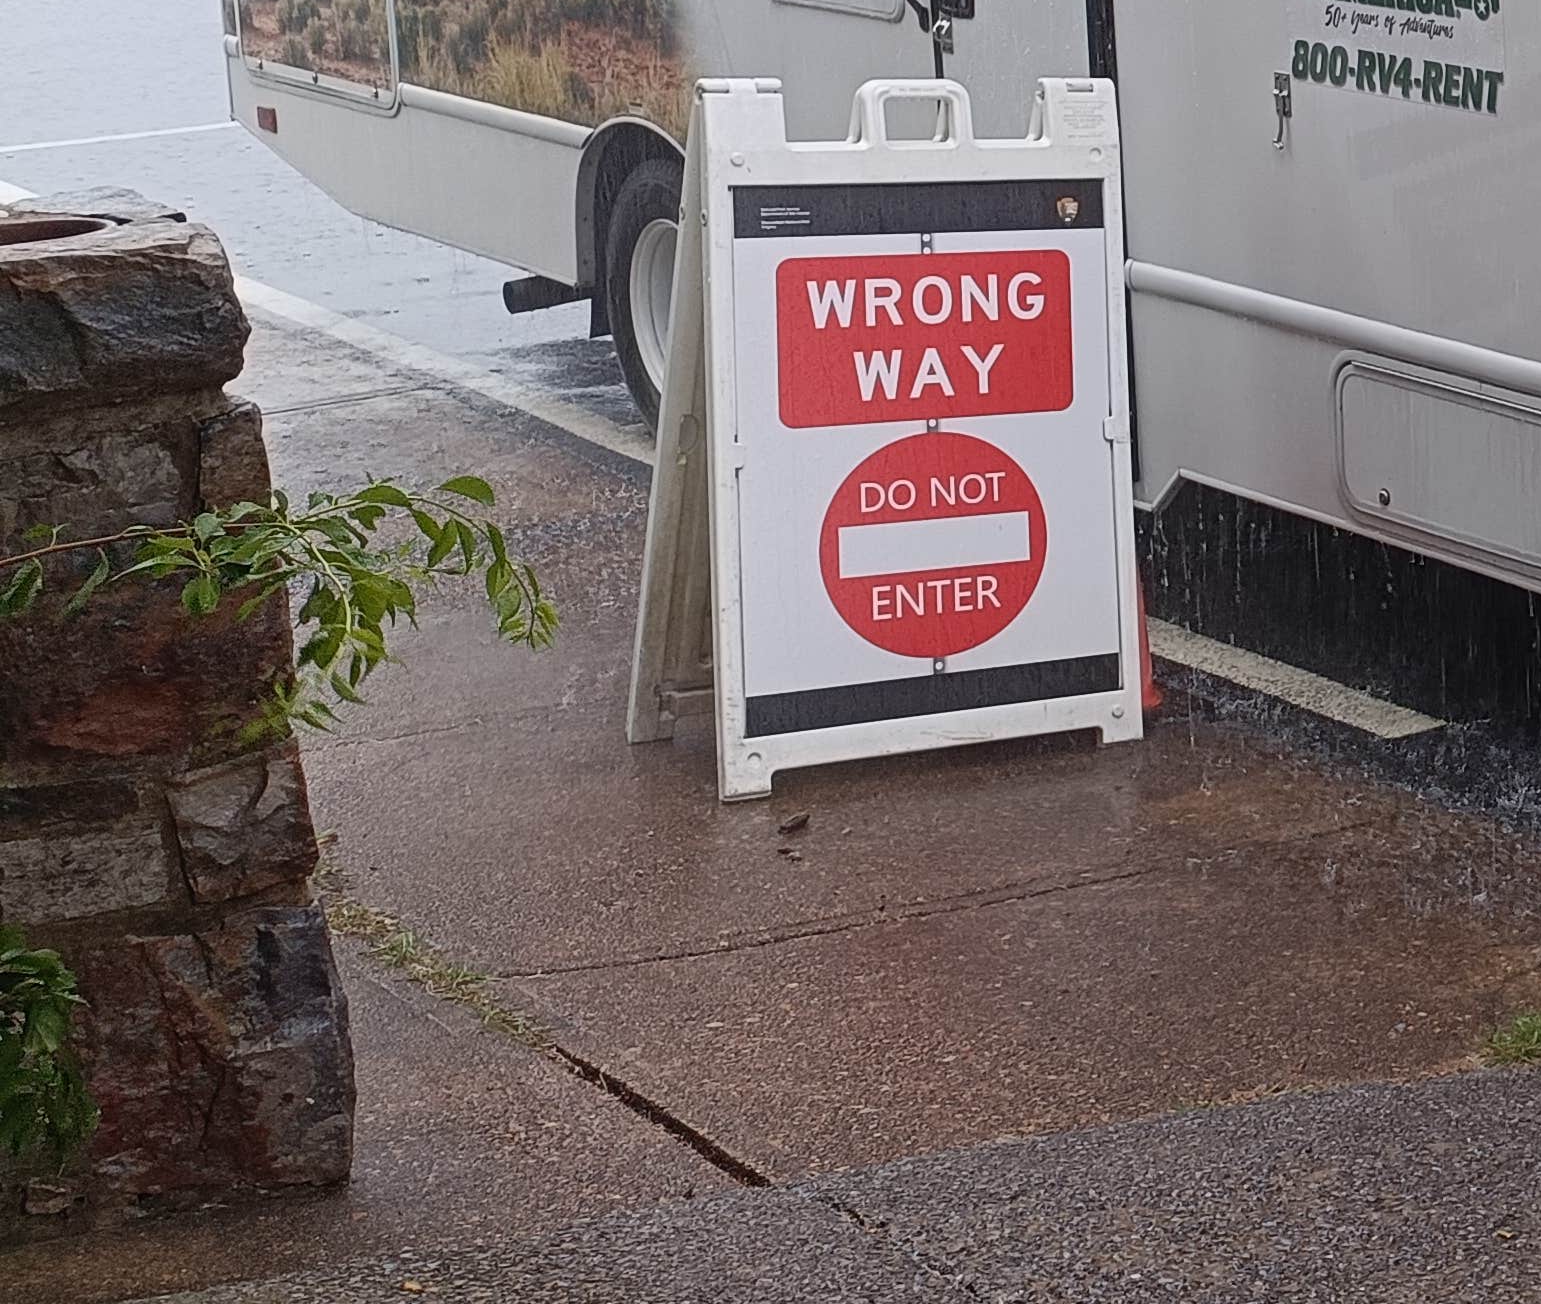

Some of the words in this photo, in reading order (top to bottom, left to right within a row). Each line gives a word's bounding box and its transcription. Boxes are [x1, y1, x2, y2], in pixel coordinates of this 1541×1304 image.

[1292, 39, 1505, 115] 800-RV4-RENT
[806, 271, 1045, 330] WRONG
[853, 344, 1005, 402] WAY
[859, 479, 917, 514] DO
[930, 472, 1006, 506] NOT
[872, 577, 1002, 622] ENTER
